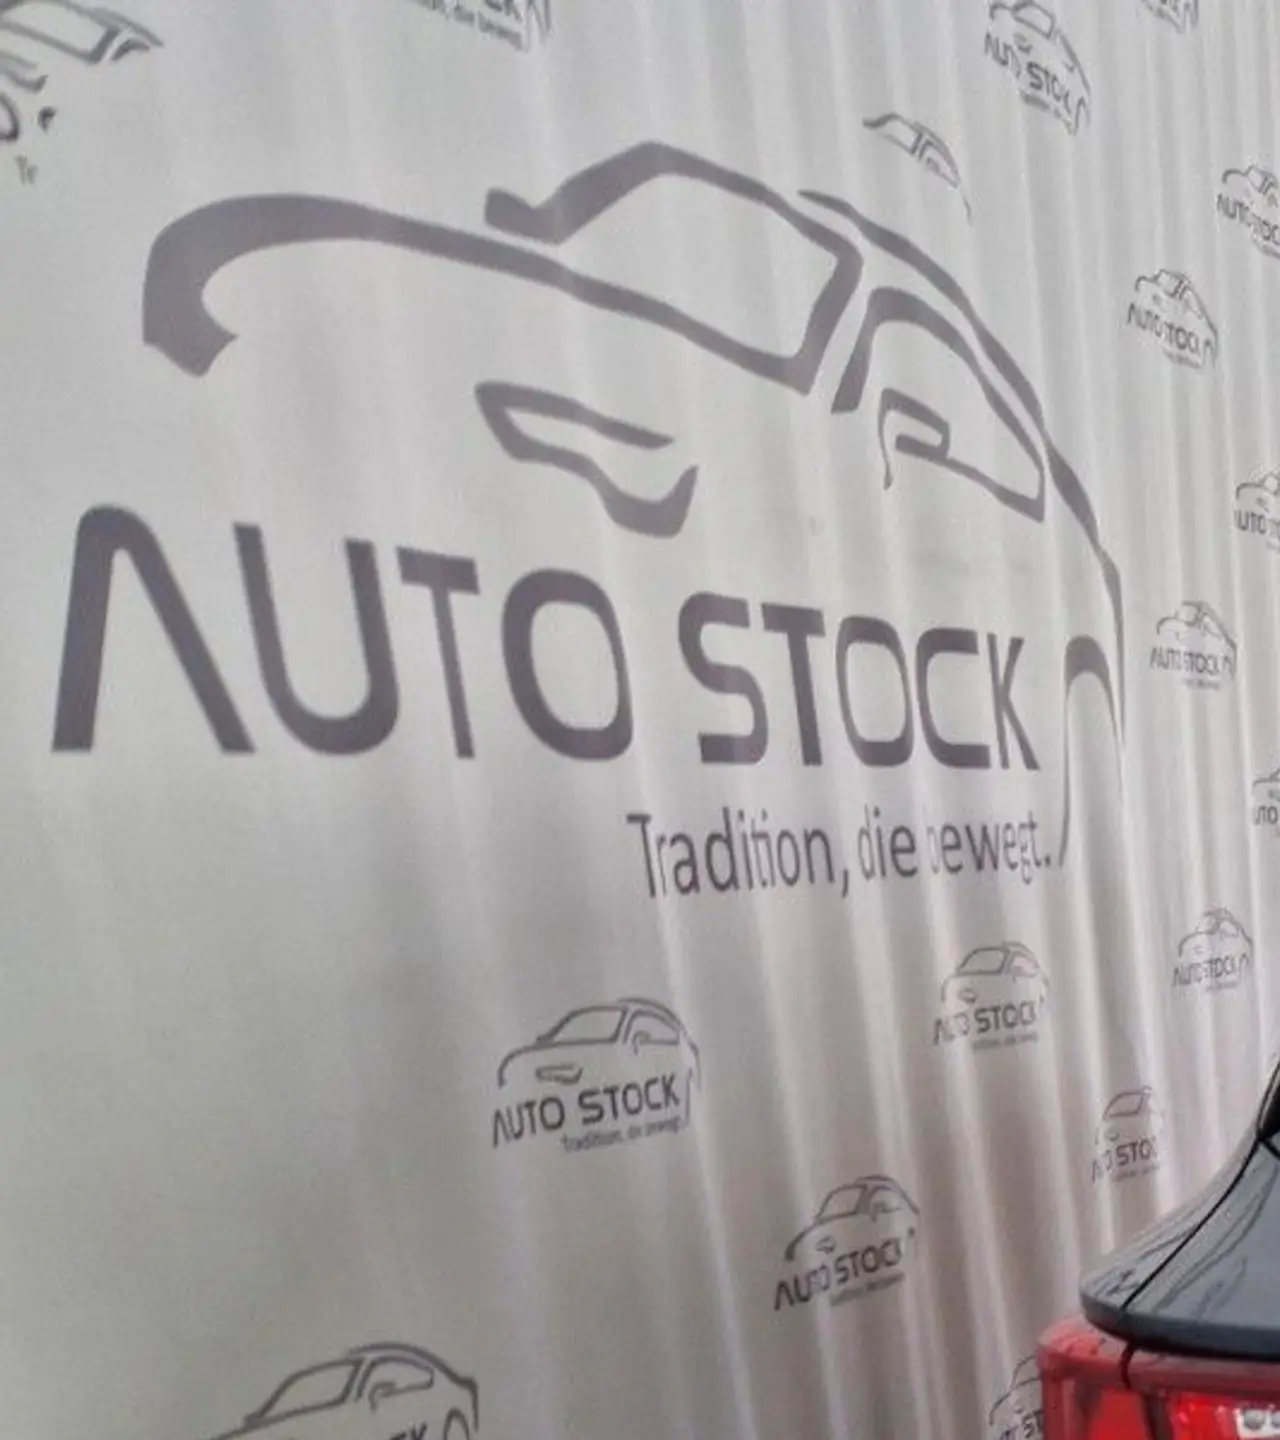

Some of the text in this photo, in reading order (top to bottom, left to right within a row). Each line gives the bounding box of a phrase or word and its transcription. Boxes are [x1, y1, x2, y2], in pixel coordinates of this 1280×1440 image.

[51, 503, 1040, 772] AUTO STOCK
[626, 805, 850, 899] Tradition,
[857, 804, 918, 880] die
[492, 1096, 566, 1148] AUTO
[576, 1073, 681, 1127] STOCK
